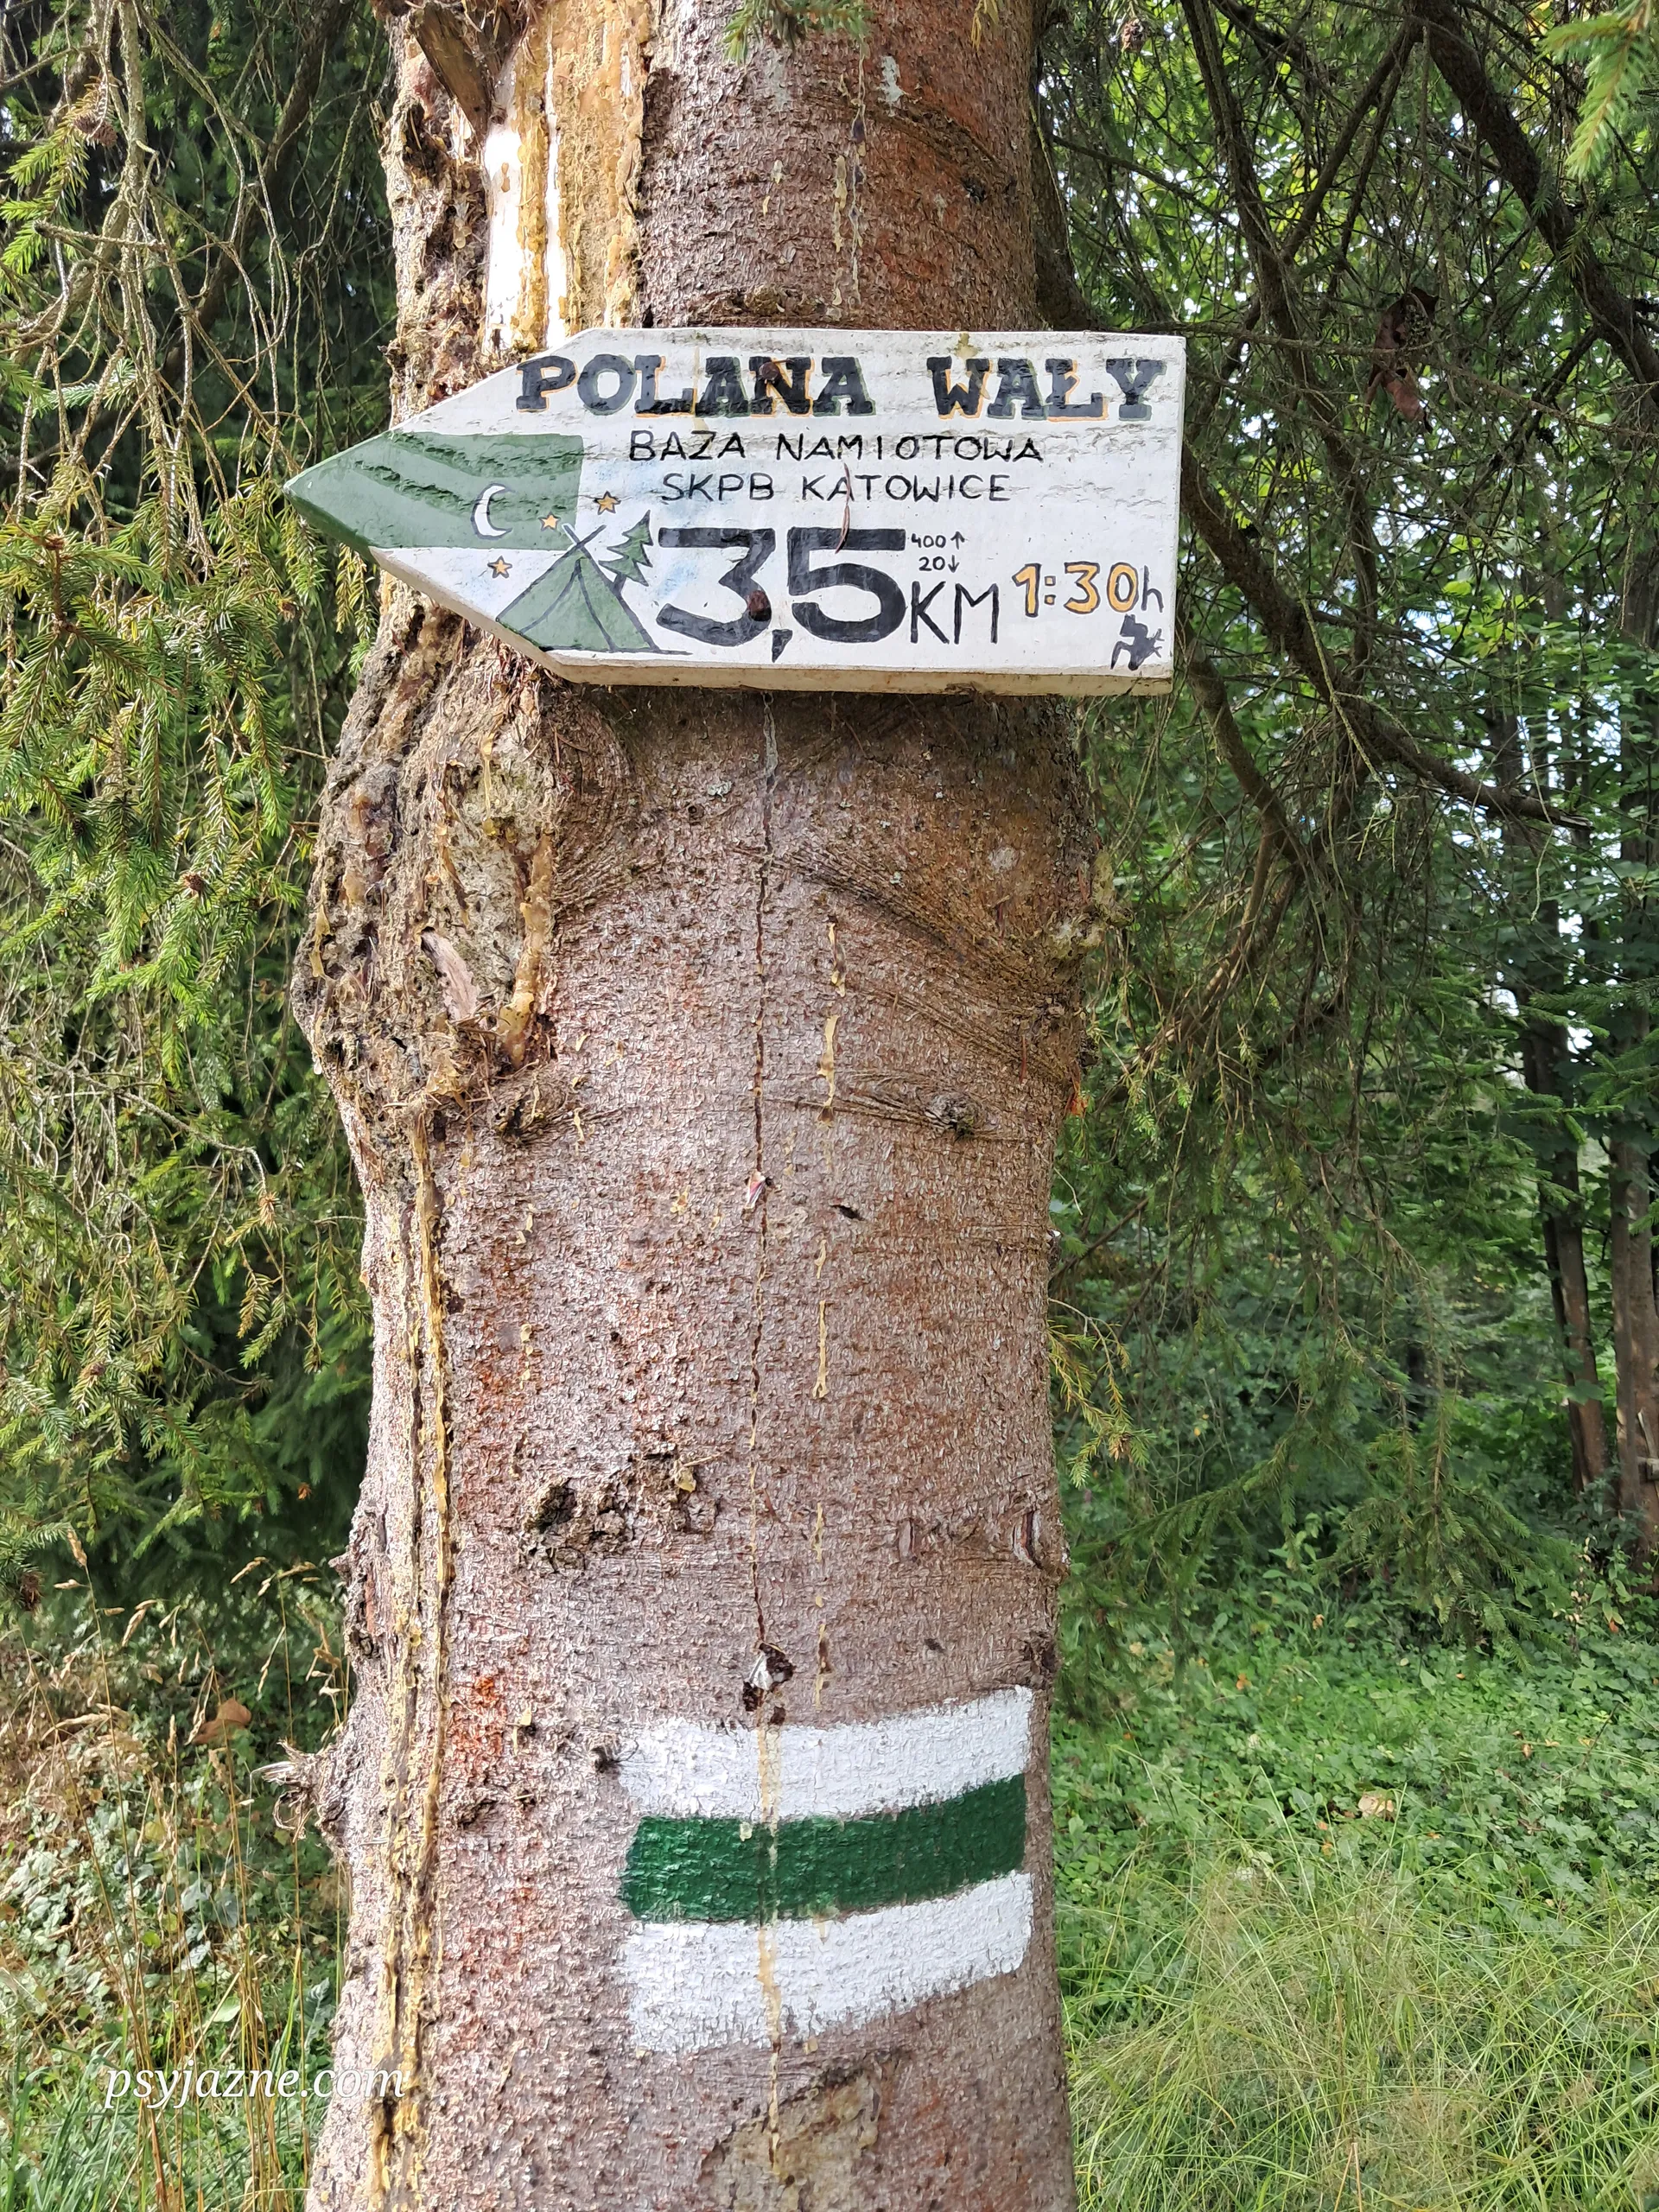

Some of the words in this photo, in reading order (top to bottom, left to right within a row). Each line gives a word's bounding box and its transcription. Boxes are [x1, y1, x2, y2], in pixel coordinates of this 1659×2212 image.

[516, 353, 875, 418] POLANA
[926, 355, 1166, 422] WAŁY
[629, 429, 746, 461] BAZA
[776, 432, 1044, 463] NAMIOTOWA
[661, 472, 774, 501] SKPB
[801, 473, 1011, 502] KATOWICE
[911, 533, 946, 549] 400
[918, 556, 946, 572] 20
[910, 581, 1000, 645] KM
